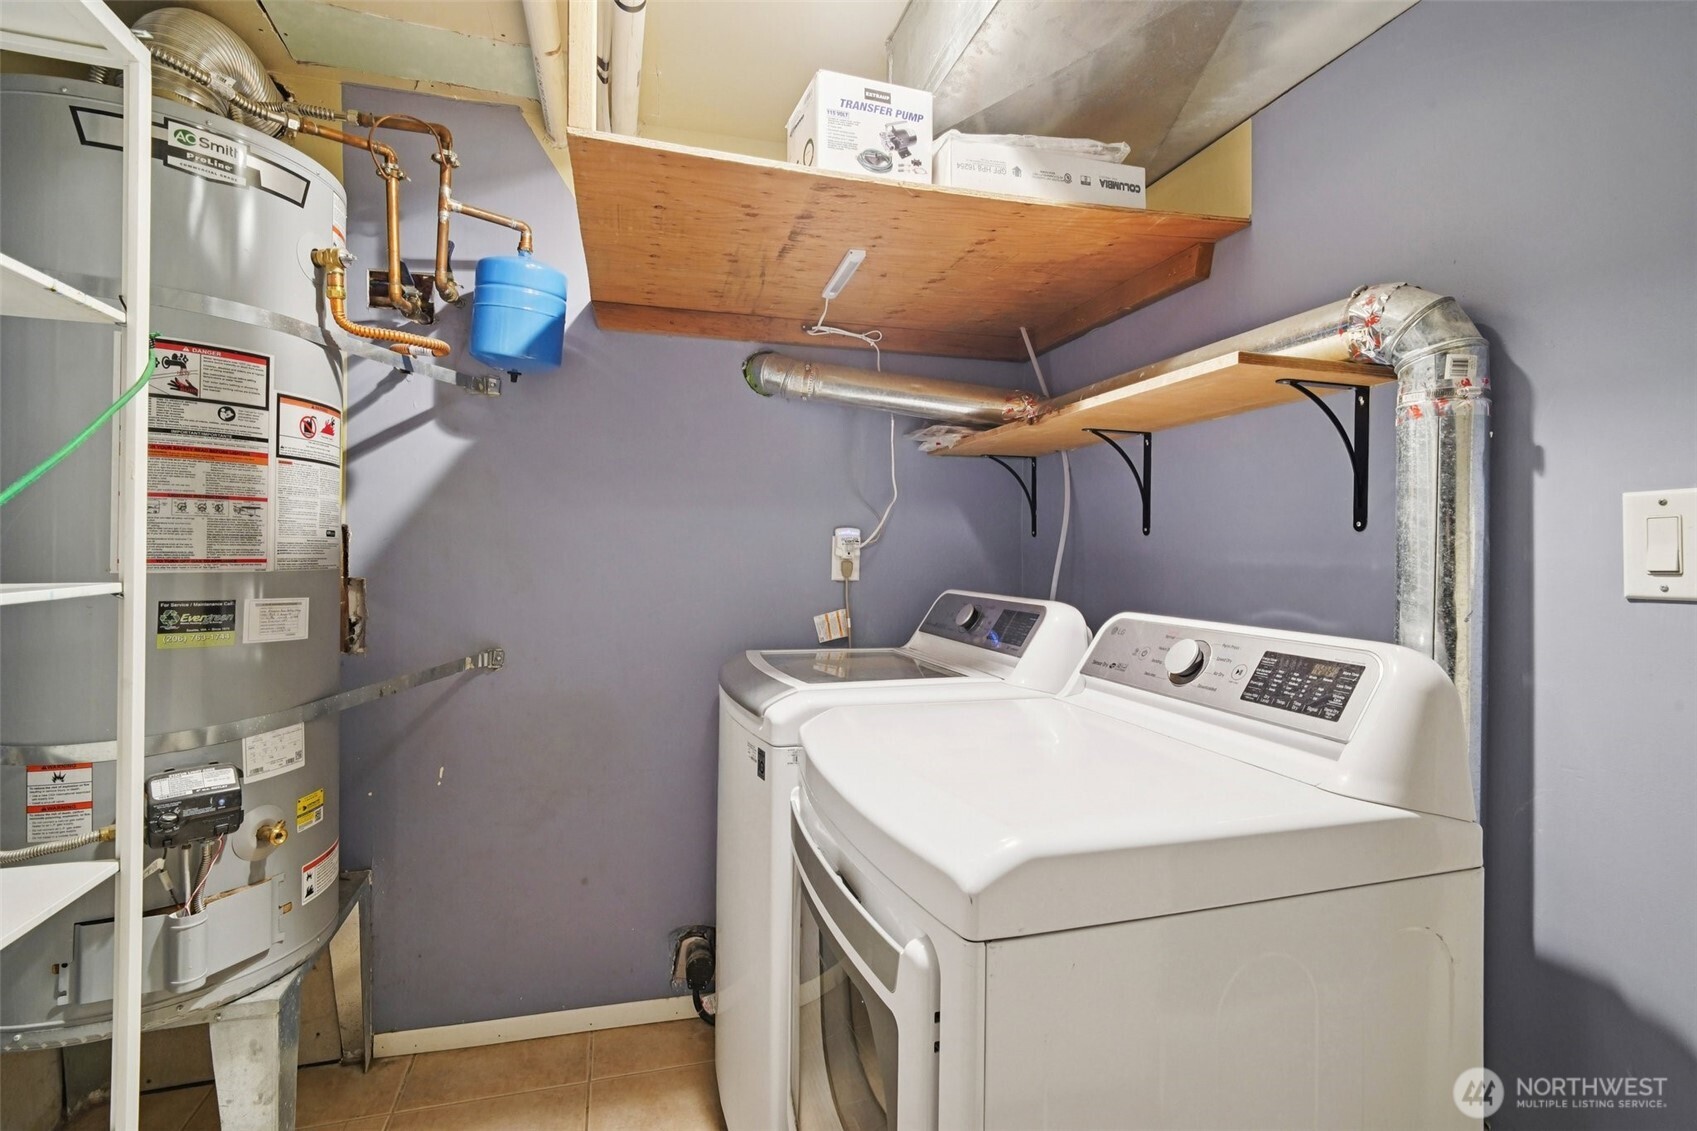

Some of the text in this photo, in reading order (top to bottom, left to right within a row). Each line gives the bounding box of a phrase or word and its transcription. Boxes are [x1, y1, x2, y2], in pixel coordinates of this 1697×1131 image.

[836, 110, 848, 118] VOLT
[840, 98, 924, 122] TRANSFER PUMP
[1098, 179, 1141, 194] COLUMBIA
[192, 348, 222, 357] DANGER
[180, 613, 235, 625] Evergreen
